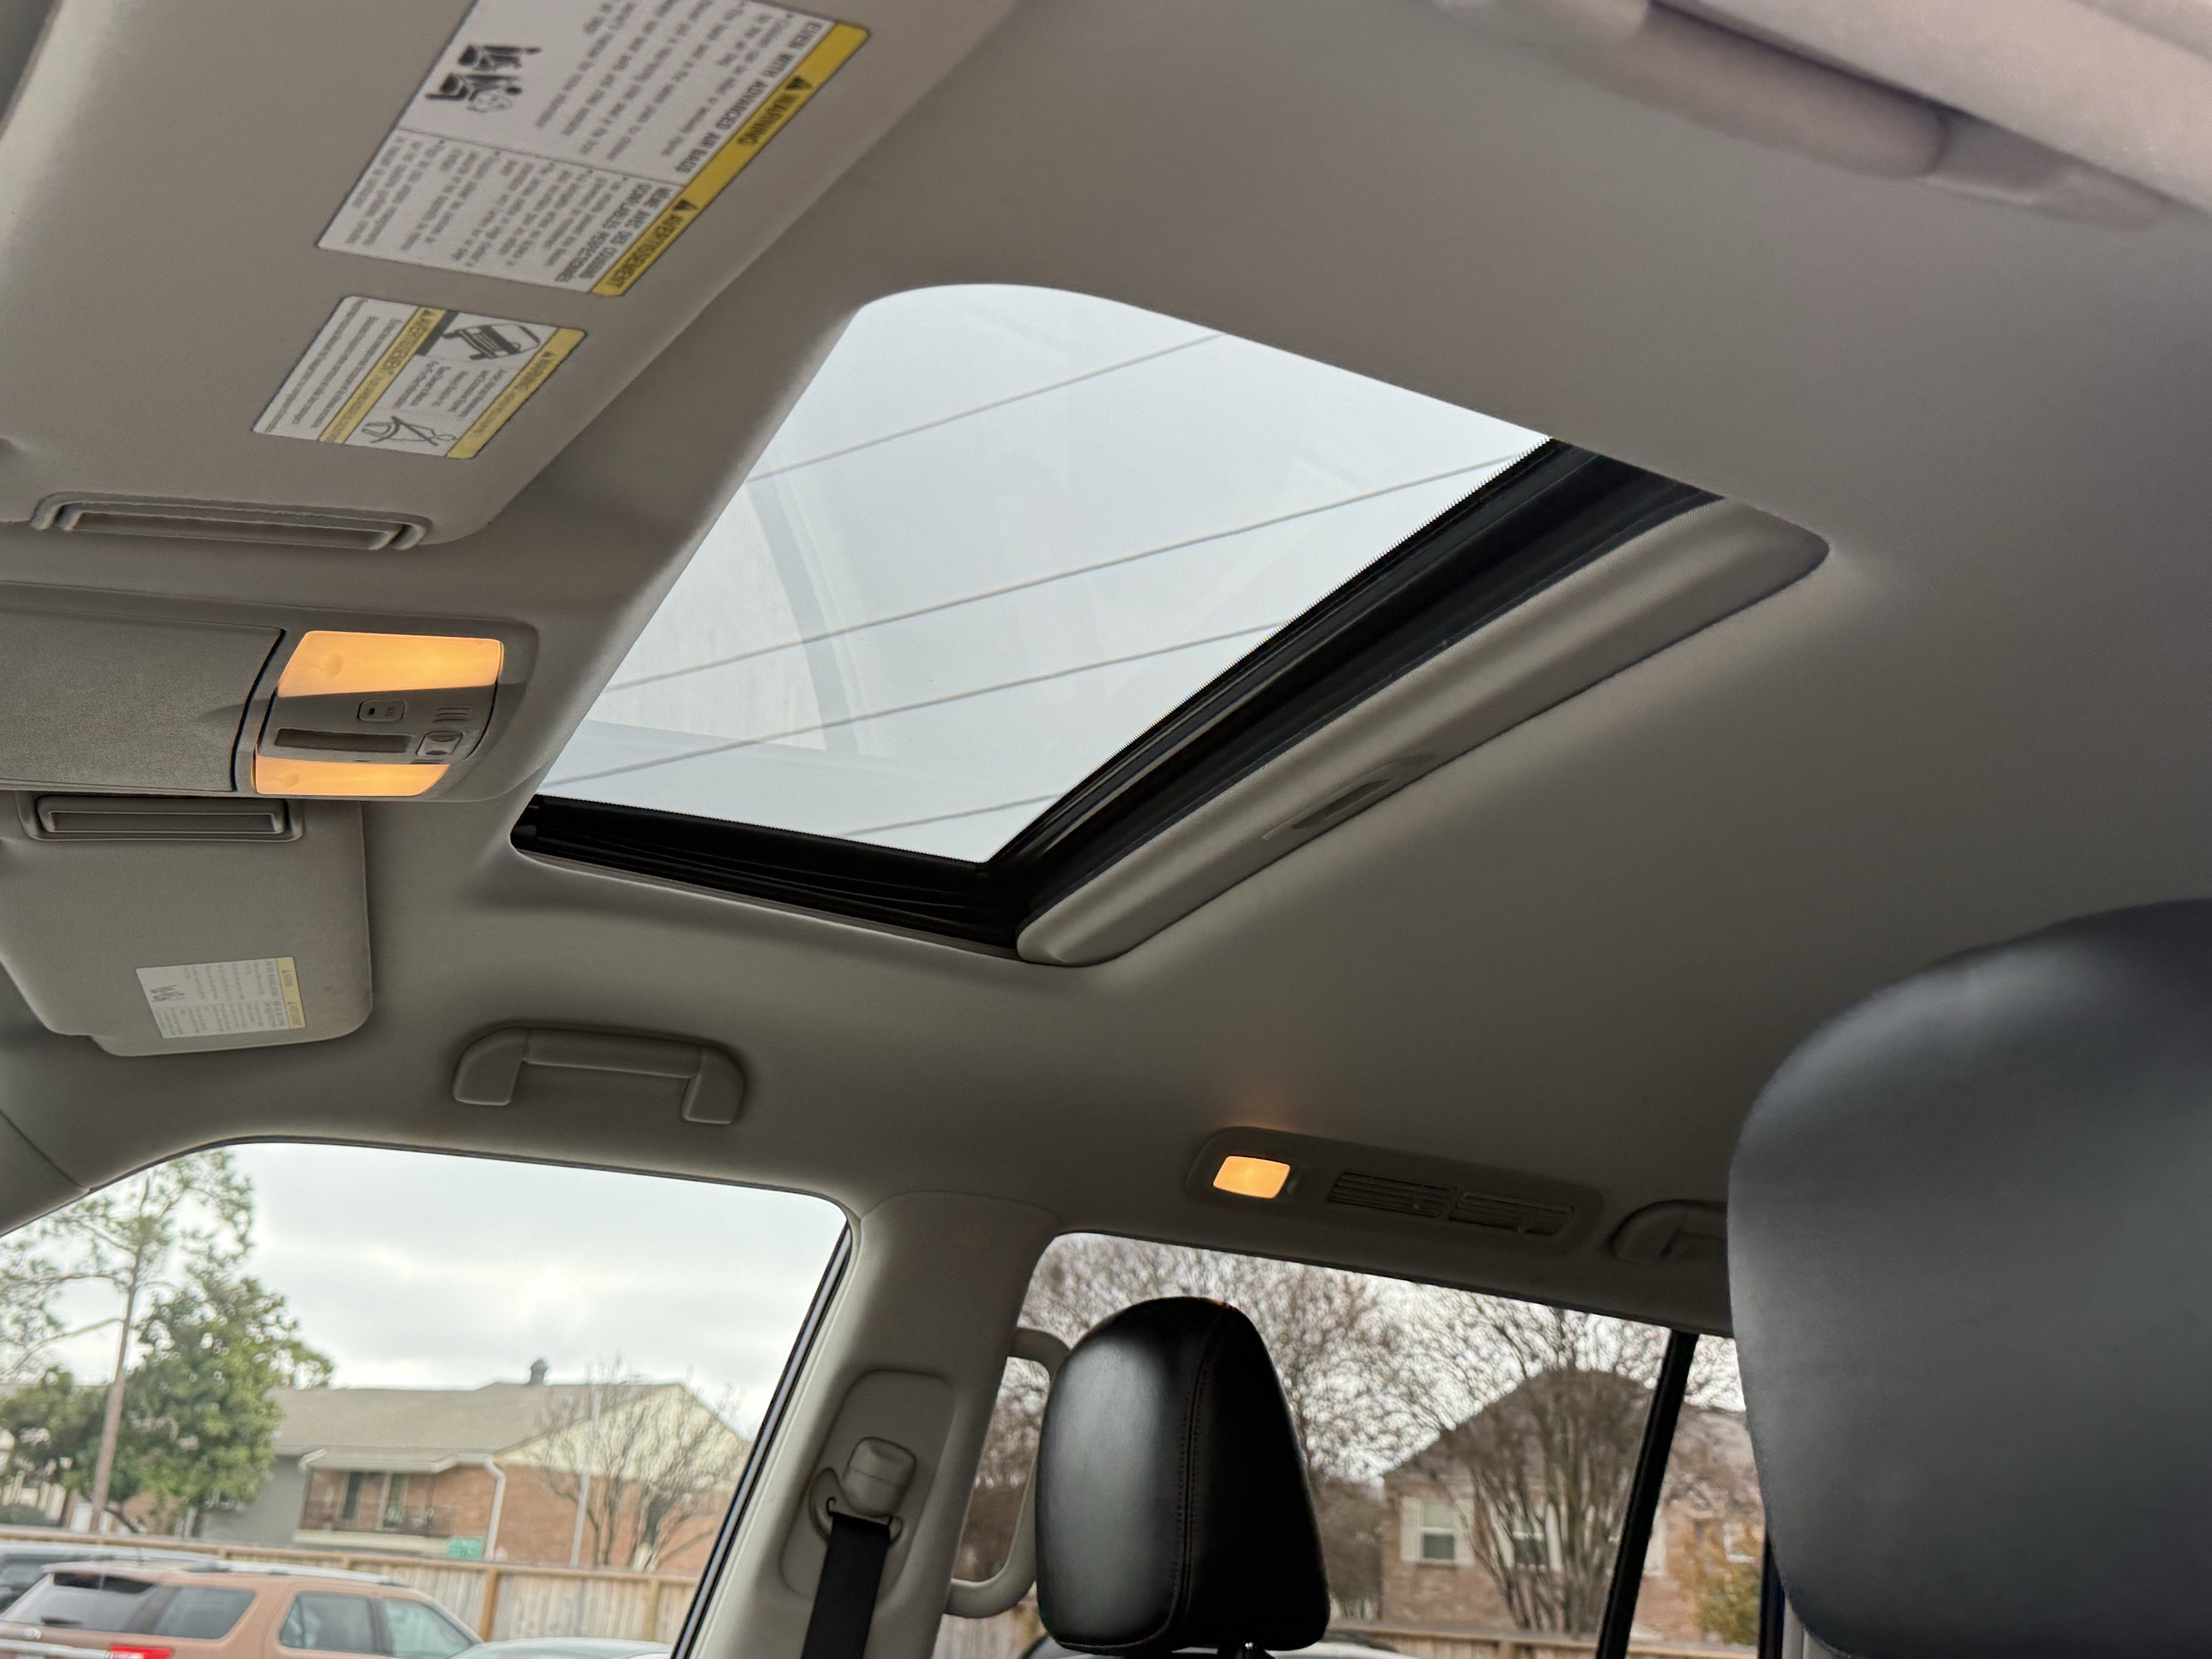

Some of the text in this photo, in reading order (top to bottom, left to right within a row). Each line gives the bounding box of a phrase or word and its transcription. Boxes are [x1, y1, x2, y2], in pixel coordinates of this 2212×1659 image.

[673, 21, 824, 174] EVEN WITH ADVANCED AIR BAGS
[735, 93, 800, 148] WARNING
[600, 182, 655, 230] GONFLABLES
[623, 209, 654, 230] AVEC
[603, 213, 688, 289] AVERTISSEMENT
[609, 230, 635, 246] DES
[577, 246, 620, 280] COUSSINS
